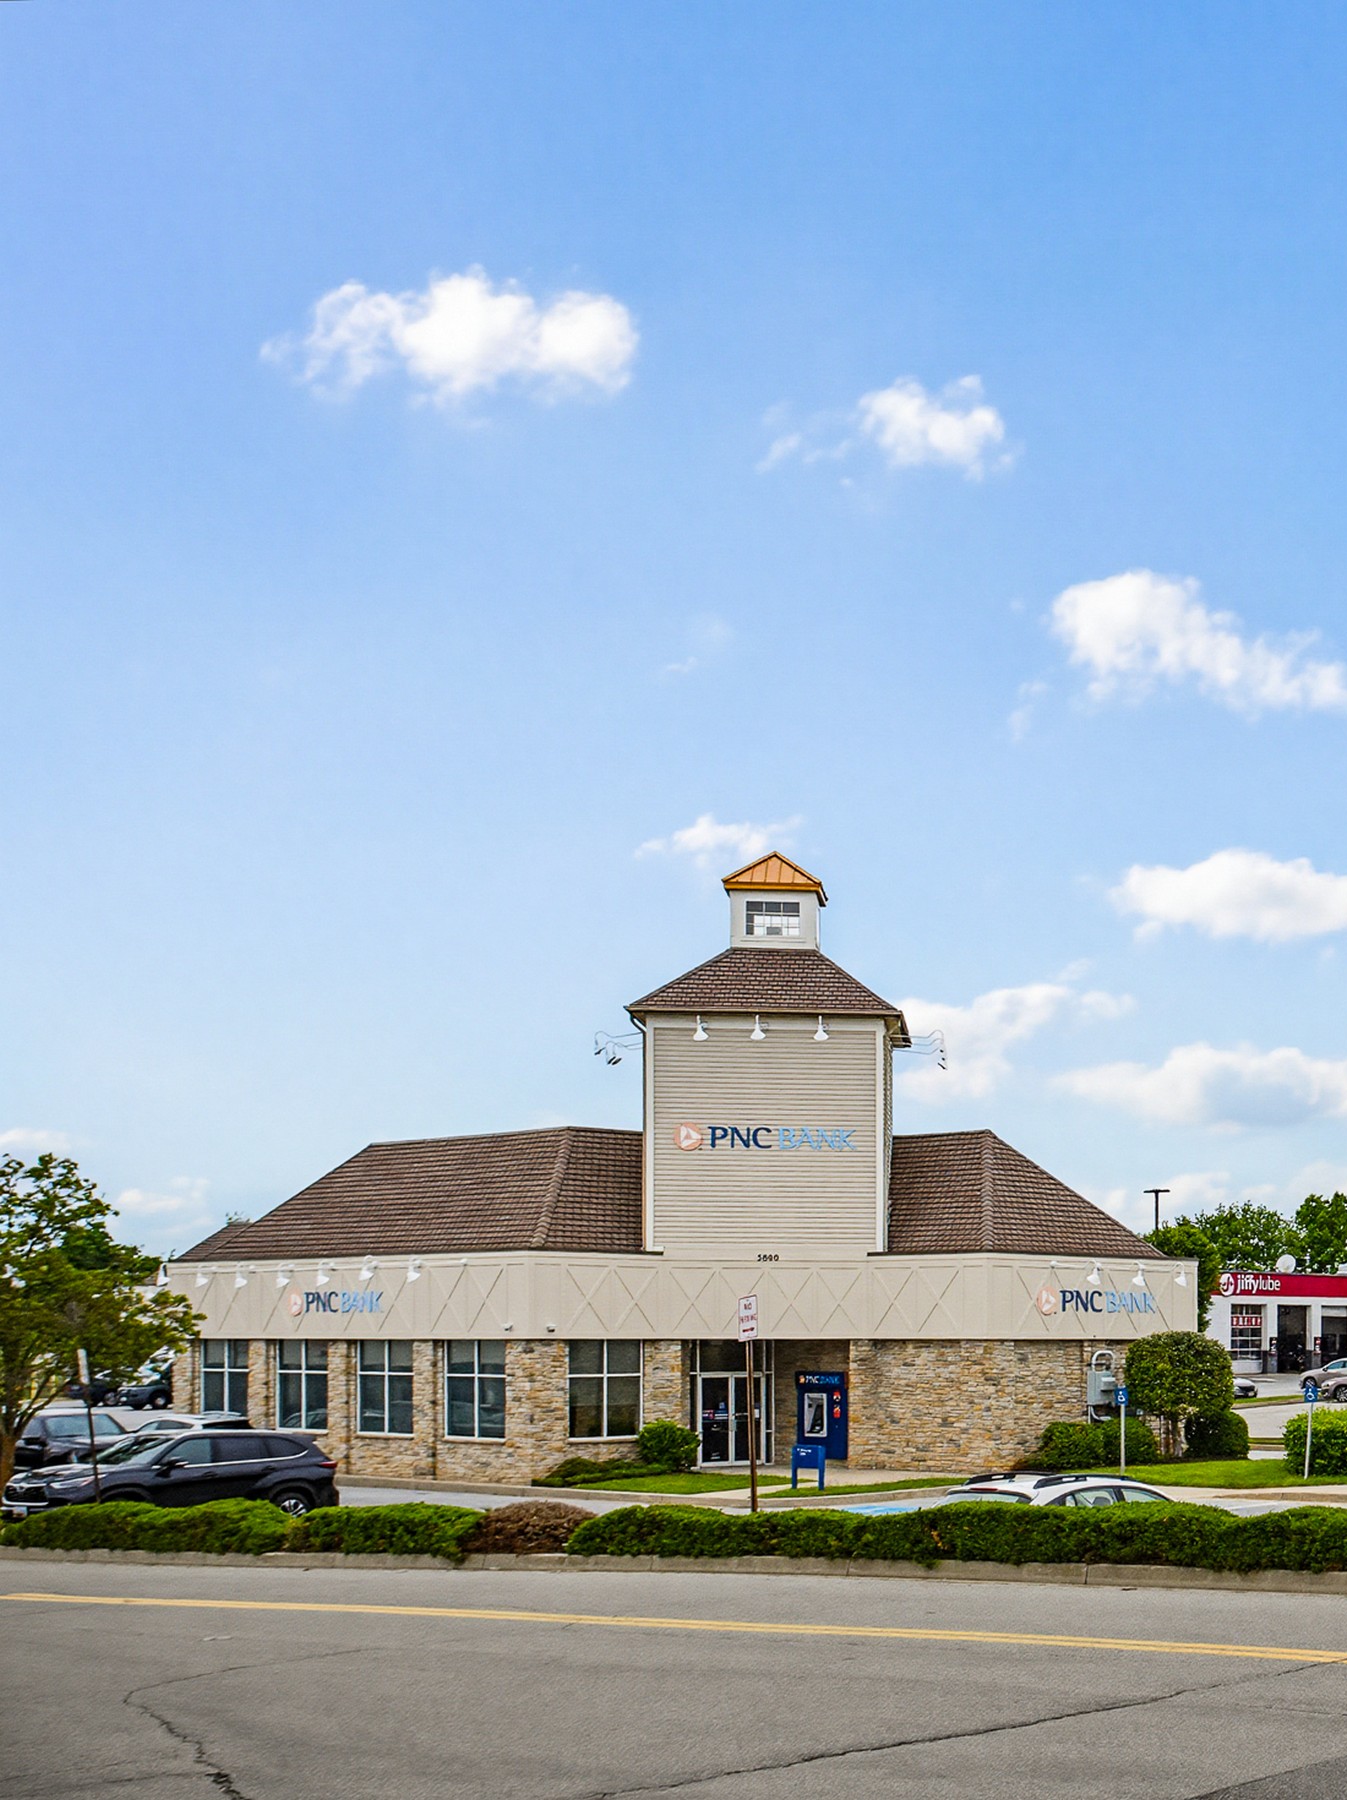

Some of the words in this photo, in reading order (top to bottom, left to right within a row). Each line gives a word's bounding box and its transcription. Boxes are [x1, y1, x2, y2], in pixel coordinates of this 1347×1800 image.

[707, 1126, 772, 1149] PNC
[779, 1127, 857, 1150] BANK
[304, 1291, 339, 1313] PNC
[340, 1291, 384, 1313] BANK
[1059, 1290, 1103, 1312] PNC
[1105, 1292, 1156, 1313] BANK
